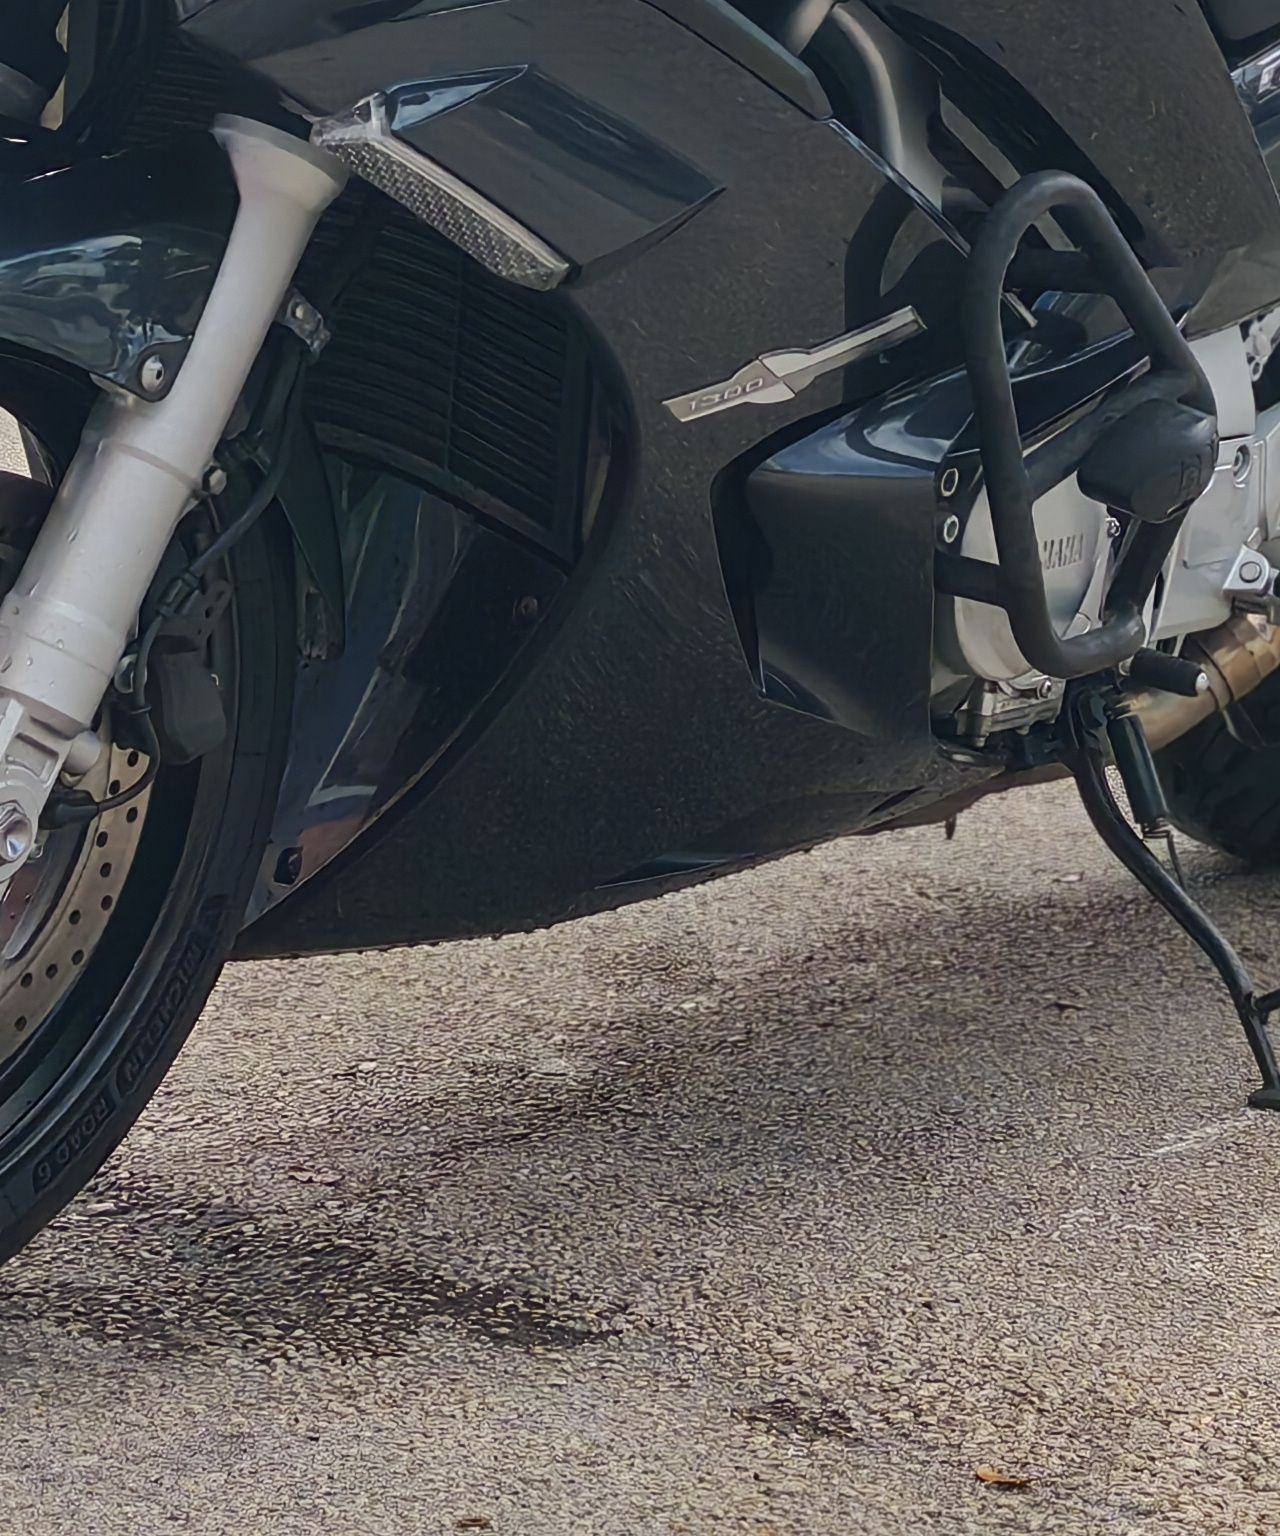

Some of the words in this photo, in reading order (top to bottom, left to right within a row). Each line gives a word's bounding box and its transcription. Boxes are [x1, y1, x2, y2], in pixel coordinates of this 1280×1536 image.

[688, 377, 763, 412] 1300
[56, 1096, 110, 1166] ROAD
[37, 1160, 52, 1185] 6
